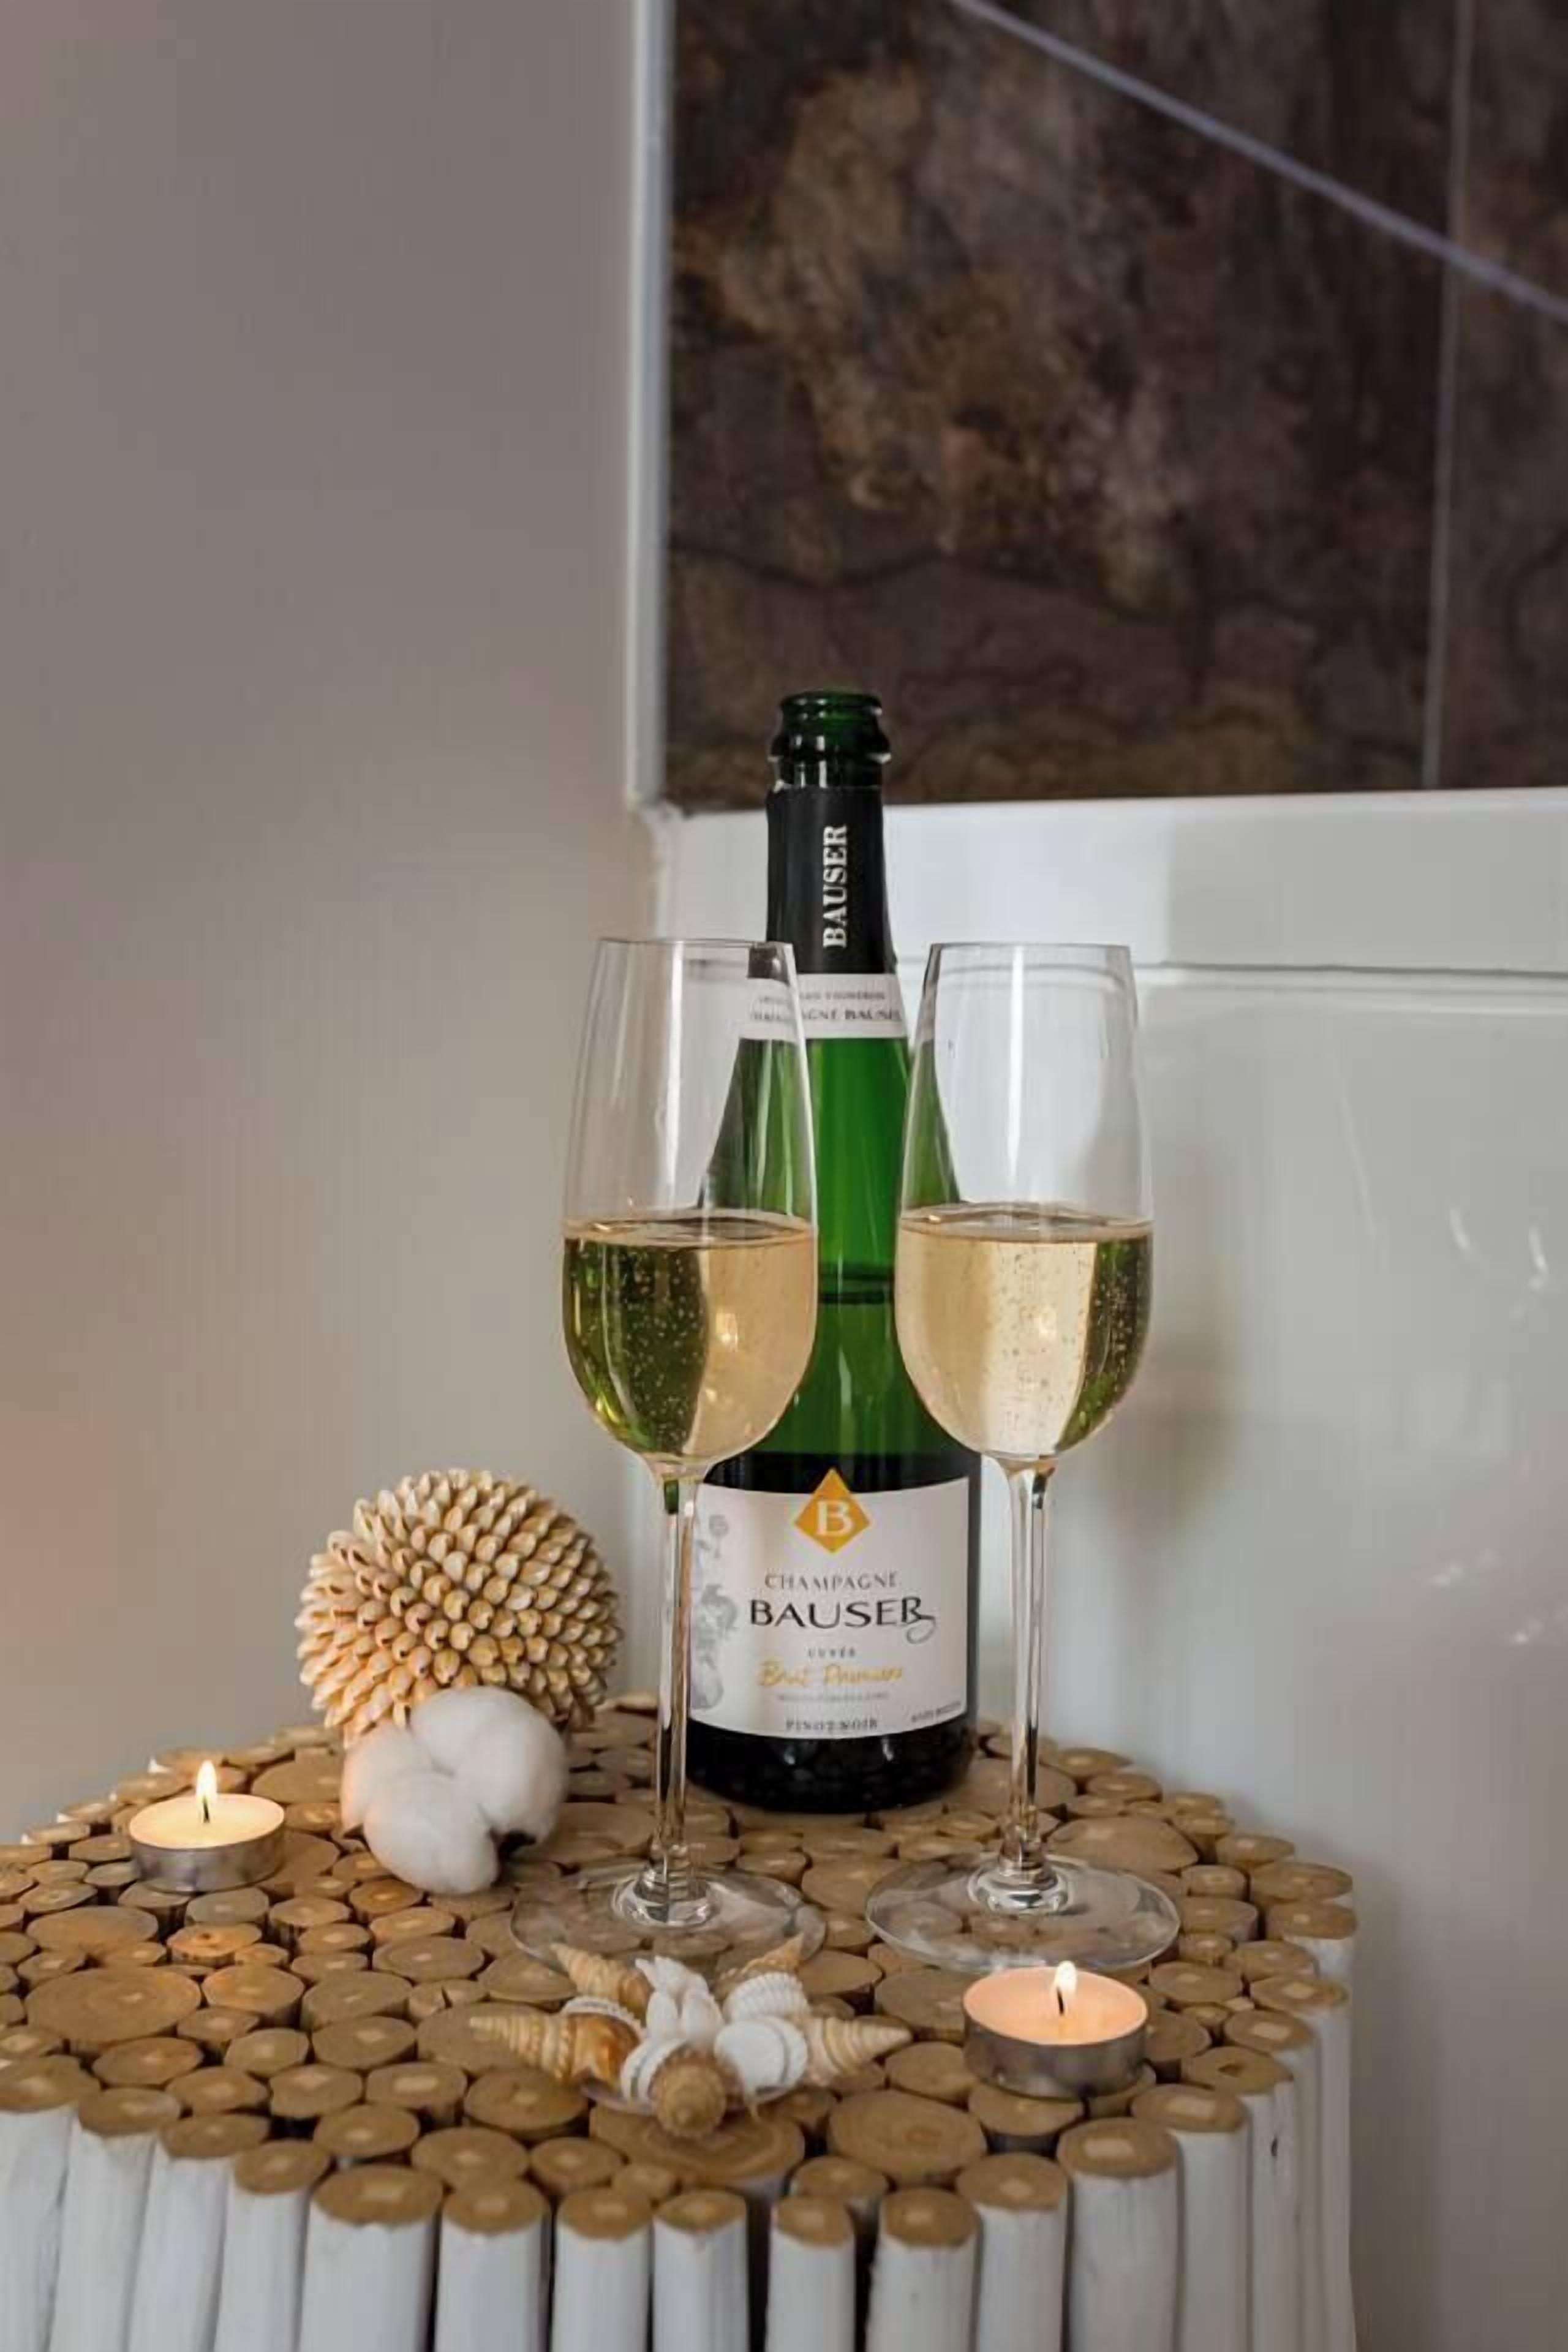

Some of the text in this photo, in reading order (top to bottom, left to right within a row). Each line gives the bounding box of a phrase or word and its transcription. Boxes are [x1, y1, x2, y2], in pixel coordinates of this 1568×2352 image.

[823, 824, 848, 948] BAUSER
[816, 1500, 853, 1536] B
[764, 1570, 899, 1591] CHAMPAGNE
[750, 1596, 936, 1644] BAUSER
